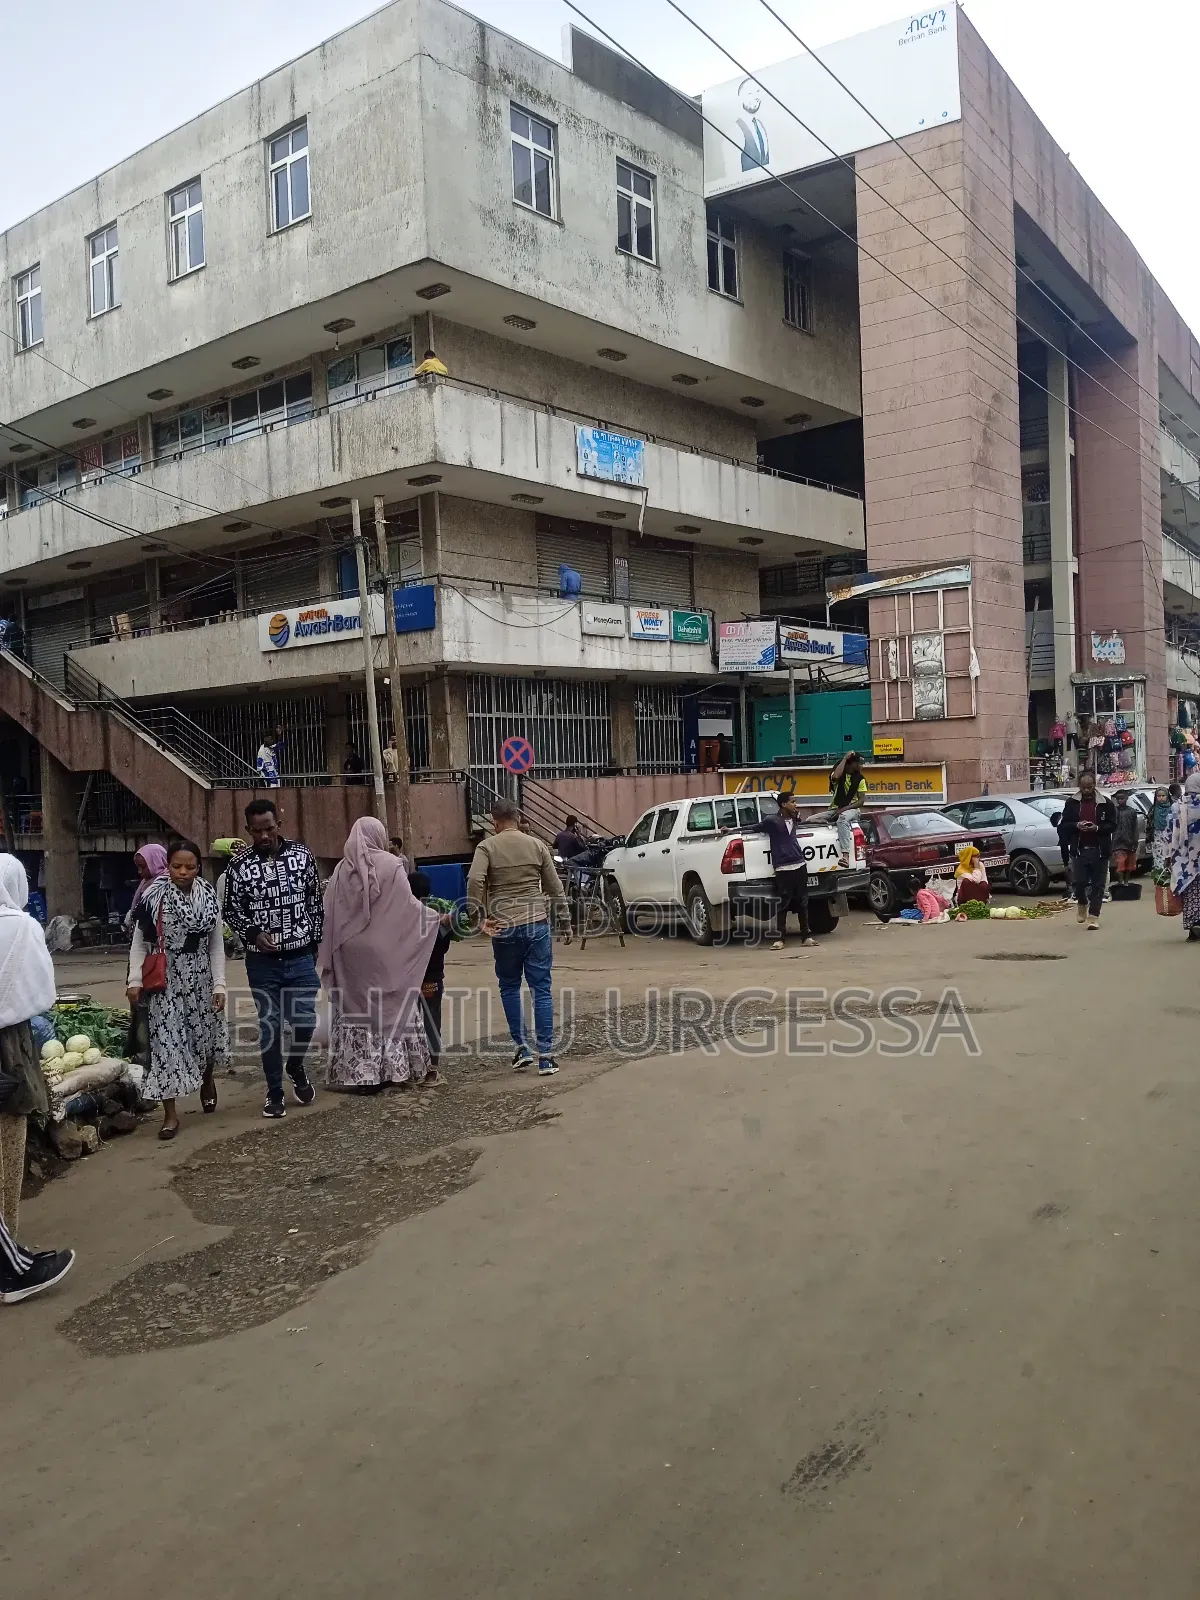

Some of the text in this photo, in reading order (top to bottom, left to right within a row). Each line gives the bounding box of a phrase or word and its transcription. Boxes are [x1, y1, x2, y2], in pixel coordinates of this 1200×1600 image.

[898, 24, 947, 47] Berhan Bank
[593, 616, 623, 625] MoneyGram
[636, 610, 661, 619] XPRESS
[643, 618, 664, 627] MONEY
[294, 614, 362, 637] AwashBan
[905, 779, 933, 790] Bank
[763, 844, 839, 865] TOTA
[276, 860, 289, 893] ADIDAS
[282, 908, 292, 940] ADIDAS
